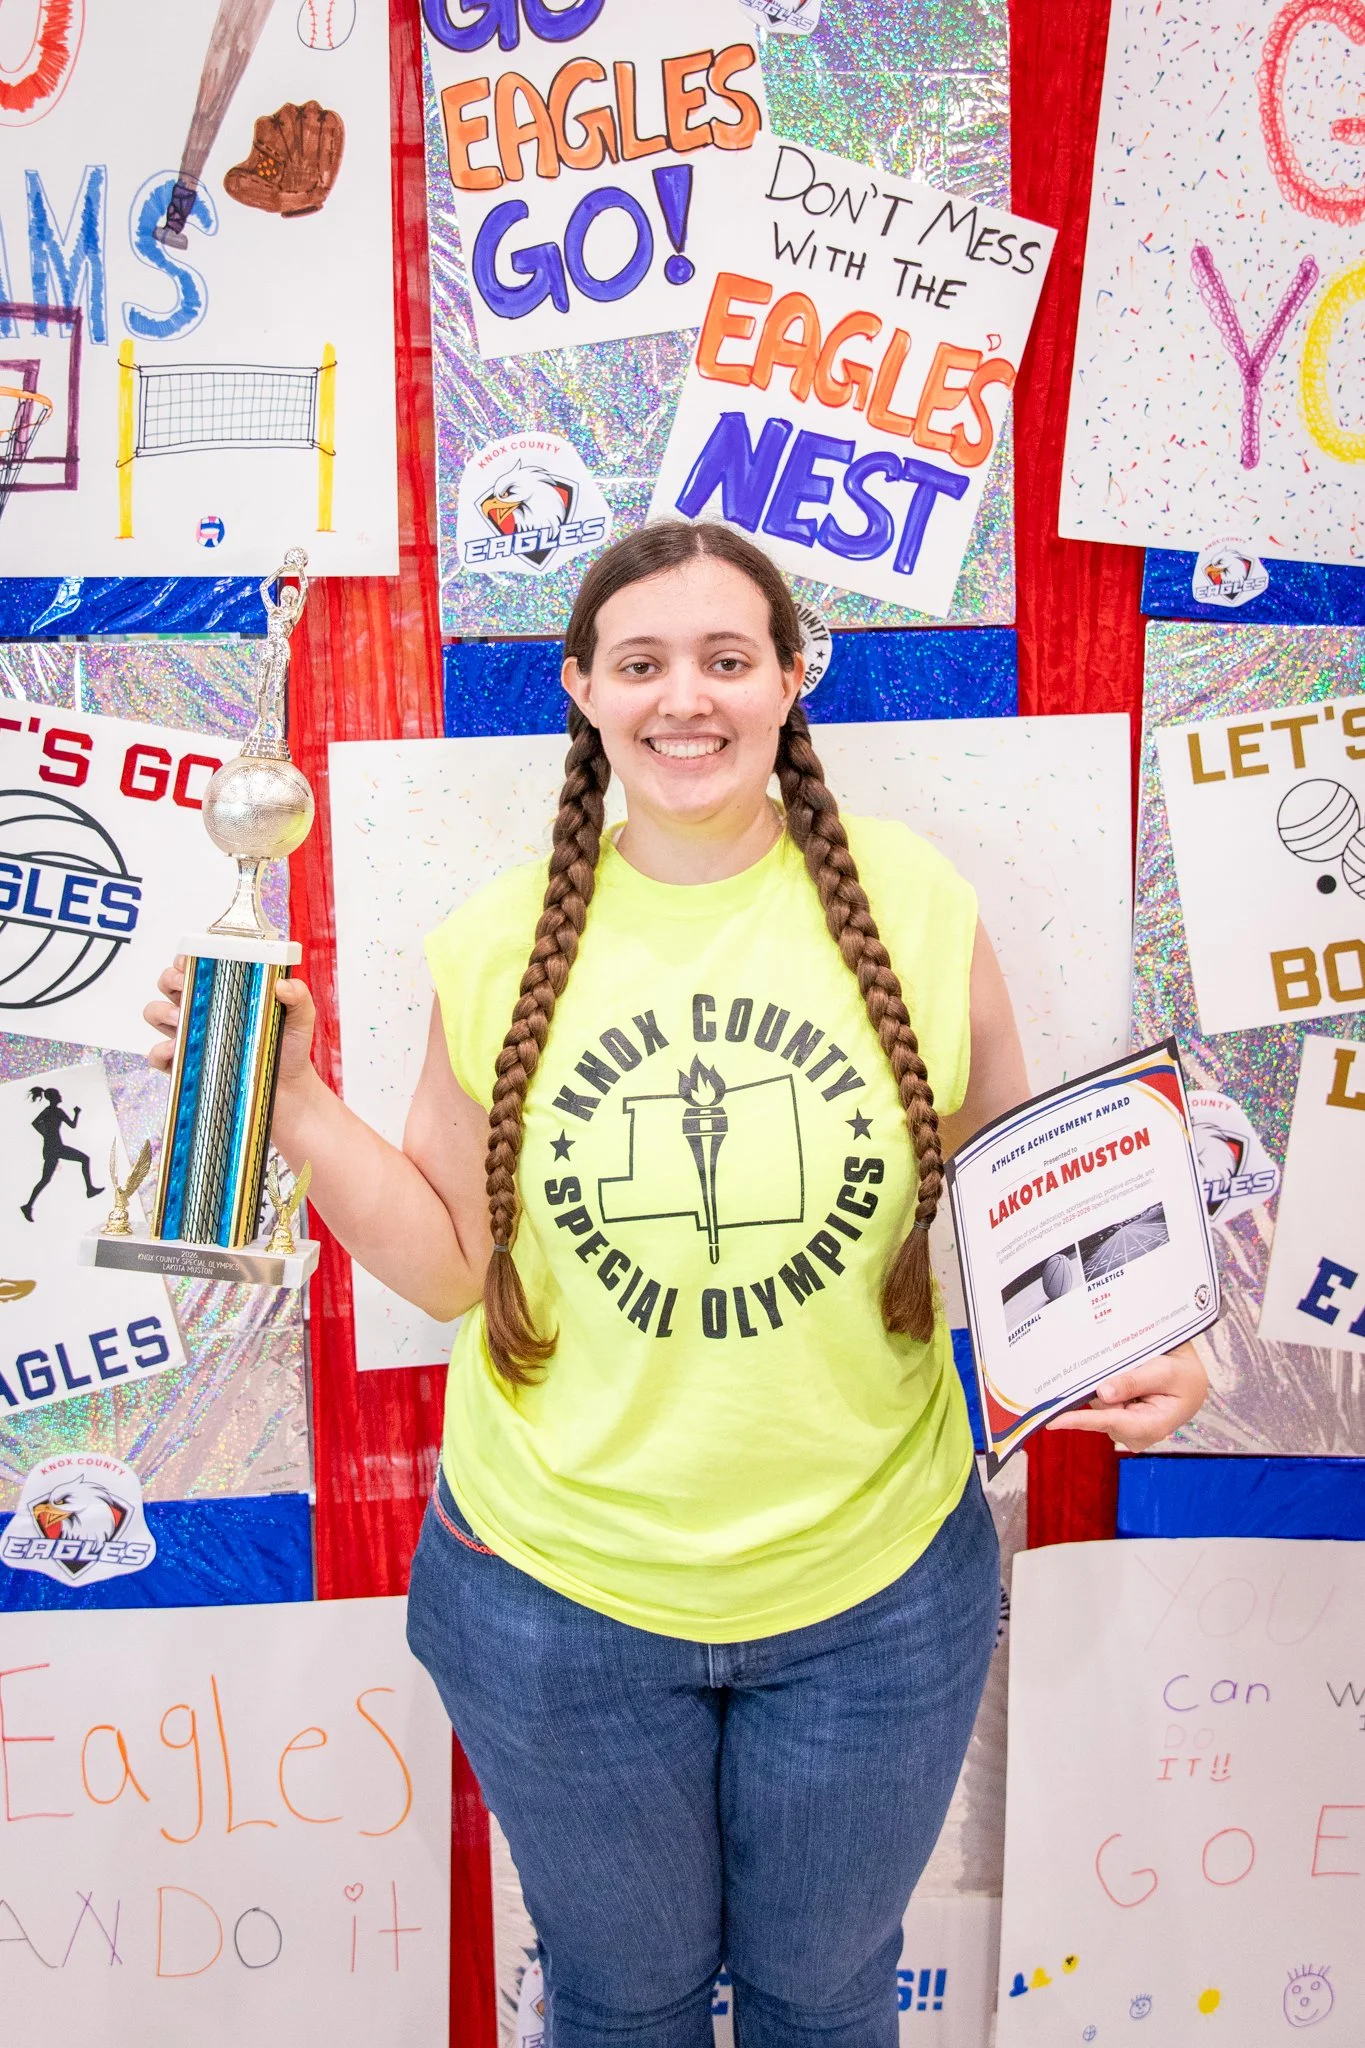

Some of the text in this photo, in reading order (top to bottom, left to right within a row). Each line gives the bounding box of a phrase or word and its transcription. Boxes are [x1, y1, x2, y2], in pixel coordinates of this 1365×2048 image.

[440, 43, 762, 192] EAGLES
[765, 144, 1042, 276] DON'T MESS
[0, 163, 219, 346] MS
[472, 163, 696, 321] GO!
[772, 222, 968, 310] WITH THE
[695, 271, 1019, 468] EAGLE'S
[477, 440, 561, 470] KNOX COUNTY
[674, 411, 971, 576] NEST
[464, 516, 606, 564] EAGLES
[1195, 576, 1267, 600] EAGLES
[119, 743, 225, 811] GO
[551, 993, 866, 1123] KNOX COUNTY
[1191, 1099, 1232, 1111] OUNTY
[991, 1096, 1131, 1174] ATHLETE ACHIEVEMENT AWARD
[1043, 1145, 1078, 1168] Presented to
[988, 1127, 1151, 1230] LAKOTA MUSTON
[1062, 1206, 1091, 1225] 2025-2026
[137, 1253, 240, 1271] KNOX COUNTY SPECIAL OLYMPICS
[162, 1263, 213, 1275] LAKOTA MUSTON
[181, 1250, 199, 1259] 2026
[544, 1156, 885, 1340] SPECIAL OLYMPICS
[1087, 1269, 1125, 1293] ATHLETICS
[1296, 1256, 1365, 1338] E
[1008, 1313, 1042, 1343] BASKETBALL
[1080, 1351, 1101, 1367] cannot
[1121, 1335, 1131, 1345] me
[1131, 1331, 1139, 1340] be
[1139, 1322, 1155, 1336] brave
[41, 1457, 126, 1477] KNOX COUNTY
[3, 1535, 151, 1566] EAGLES
[1133, 1547, 1336, 1652] YOU
[1163, 1674, 1271, 1712] Can
[344, 1881, 422, 1974] it
